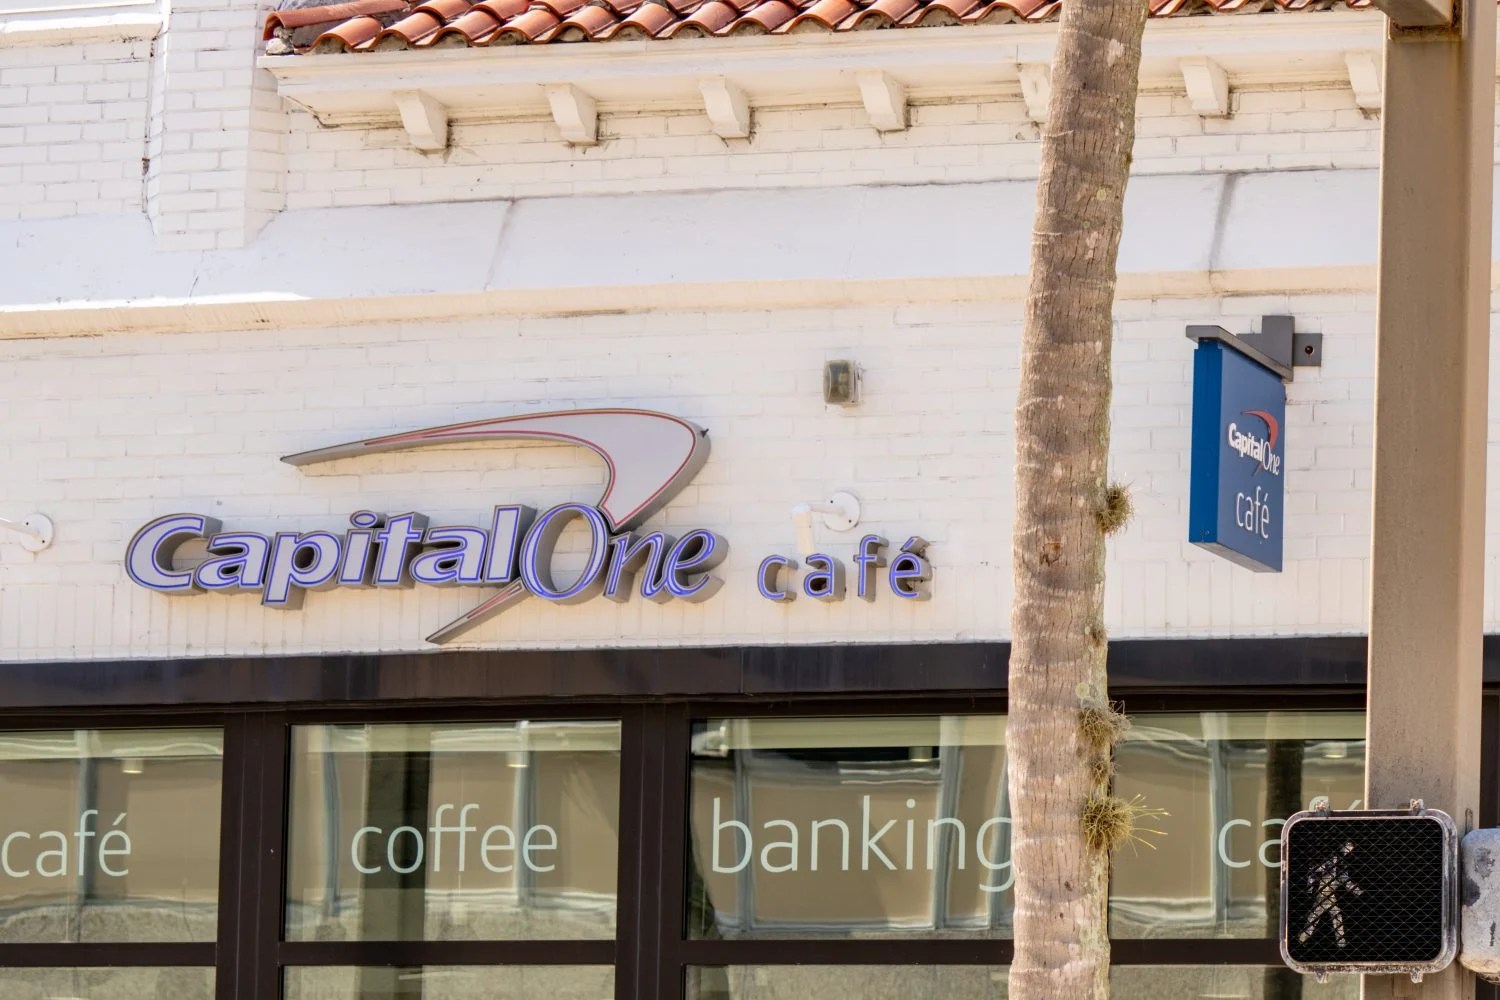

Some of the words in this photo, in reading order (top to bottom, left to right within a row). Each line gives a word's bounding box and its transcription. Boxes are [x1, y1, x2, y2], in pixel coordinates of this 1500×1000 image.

[1236, 485, 1270, 539] café
[756, 534, 932, 602] café
[0, 809, 132, 879] café
[350, 803, 558, 875] coffee
[709, 794, 1015, 892] banking
